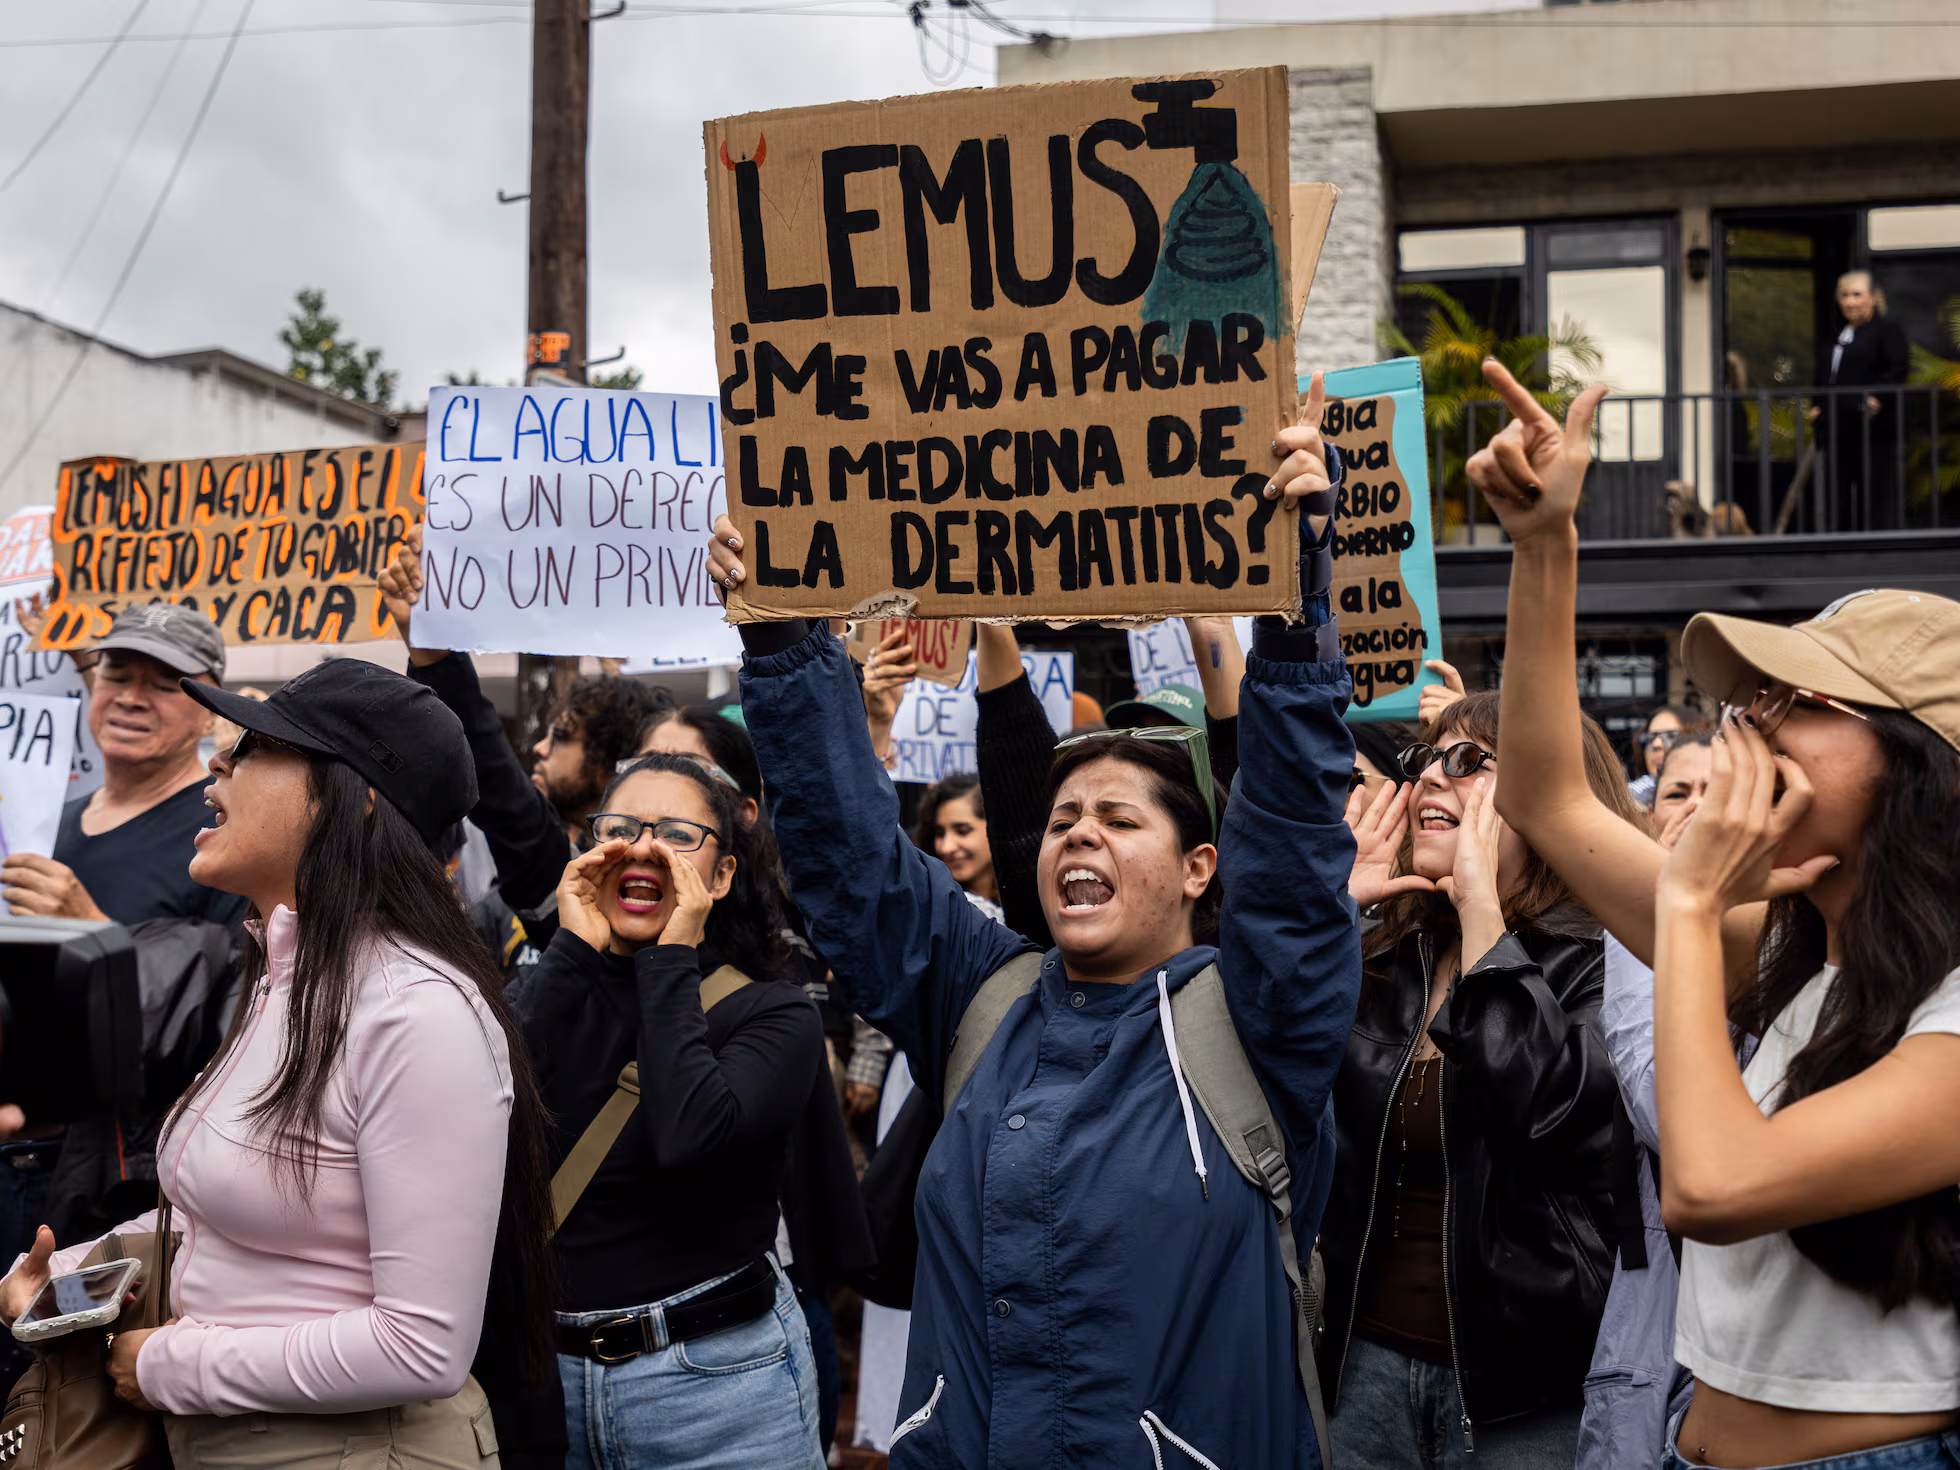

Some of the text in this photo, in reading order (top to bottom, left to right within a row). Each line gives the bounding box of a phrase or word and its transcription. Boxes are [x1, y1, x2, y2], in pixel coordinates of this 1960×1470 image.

[735, 118, 1161, 324] LEMUS
[721, 313, 1268, 426] ¿ME VAS A PAGAR
[441, 394, 725, 467] EL AGUA LI
[739, 405, 1248, 508] LA MEDICINA DE
[53, 460, 151, 544] LEMUS
[192, 452, 291, 526] AGUA
[300, 448, 344, 521] ES
[428, 473, 478, 532] ES
[501, 473, 562, 532] UN
[755, 472, 1279, 597] LA DERMATITIS?
[207, 521, 255, 587] DE
[300, 507, 417, 583] GOBIER
[426, 546, 485, 611] NO
[508, 545, 576, 609] UN
[238, 585, 356, 643] CACA
[915, 696, 958, 737] DE
